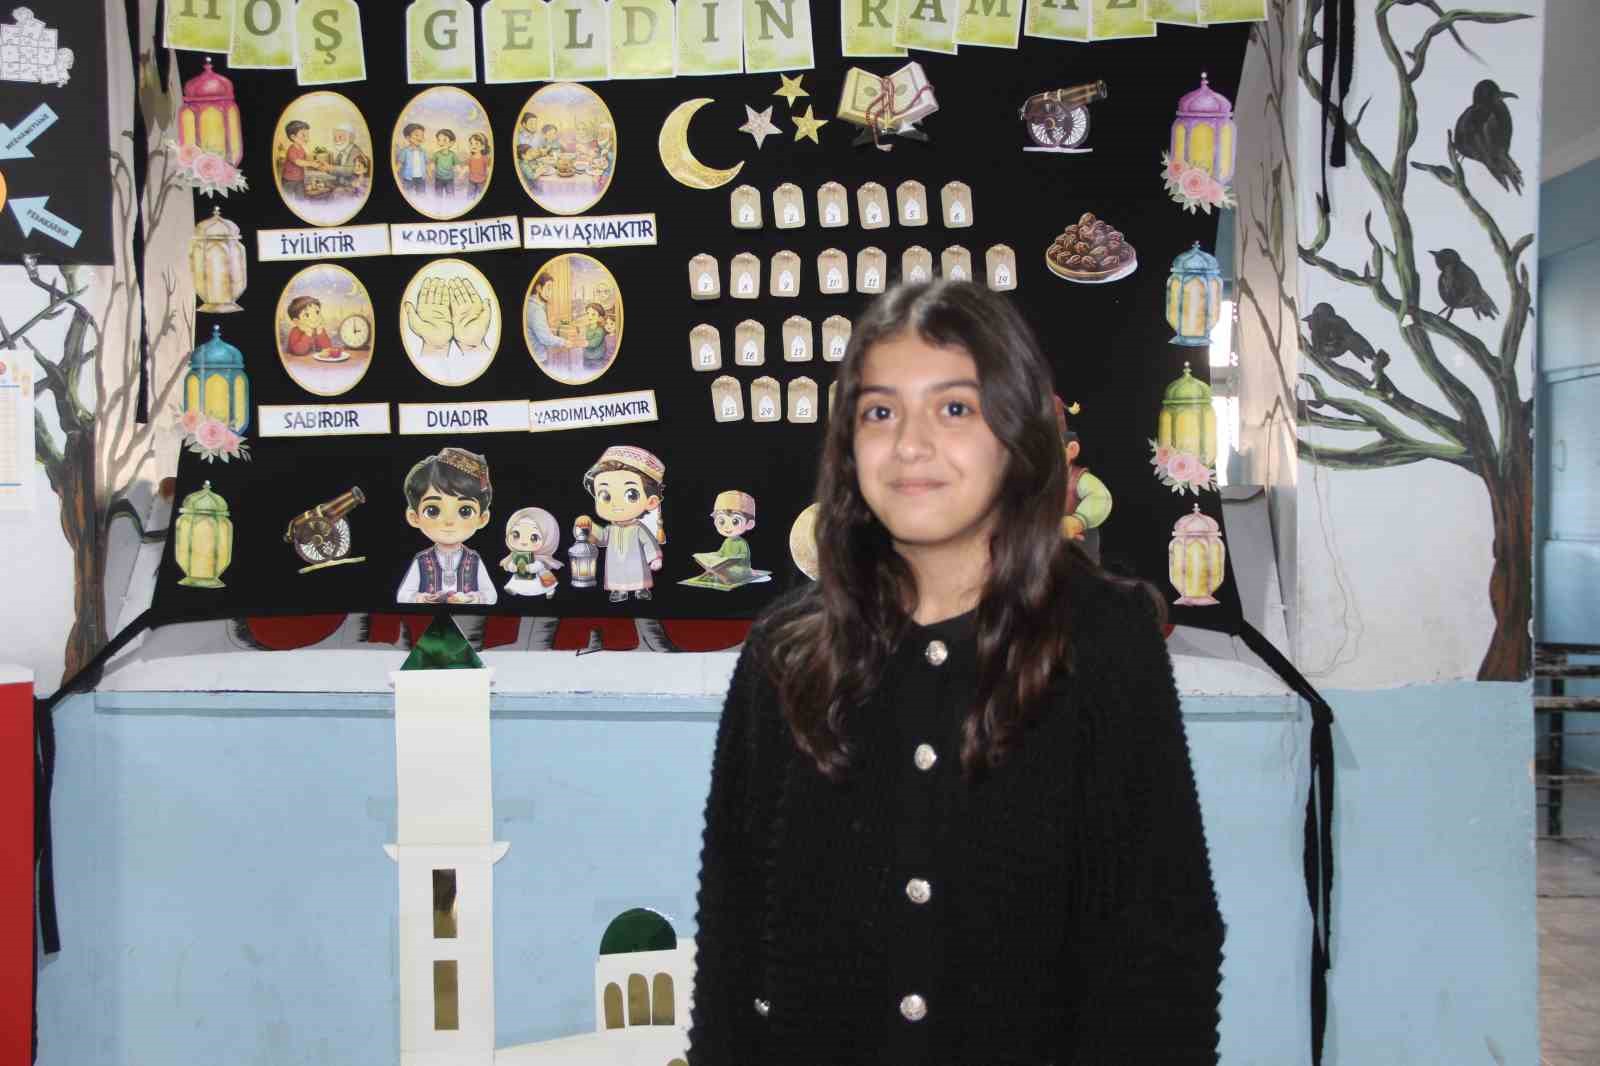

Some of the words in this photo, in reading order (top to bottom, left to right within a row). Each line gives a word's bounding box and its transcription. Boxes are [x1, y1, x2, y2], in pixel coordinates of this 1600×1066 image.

[281, 231, 356, 255] İYİLİKTİR
[402, 219, 514, 250] KARDEŞLİKTİR
[530, 219, 654, 246] PAYLAŞMAKTIR
[283, 410, 360, 429] SABIRDIR
[426, 408, 489, 428] DUADIR
